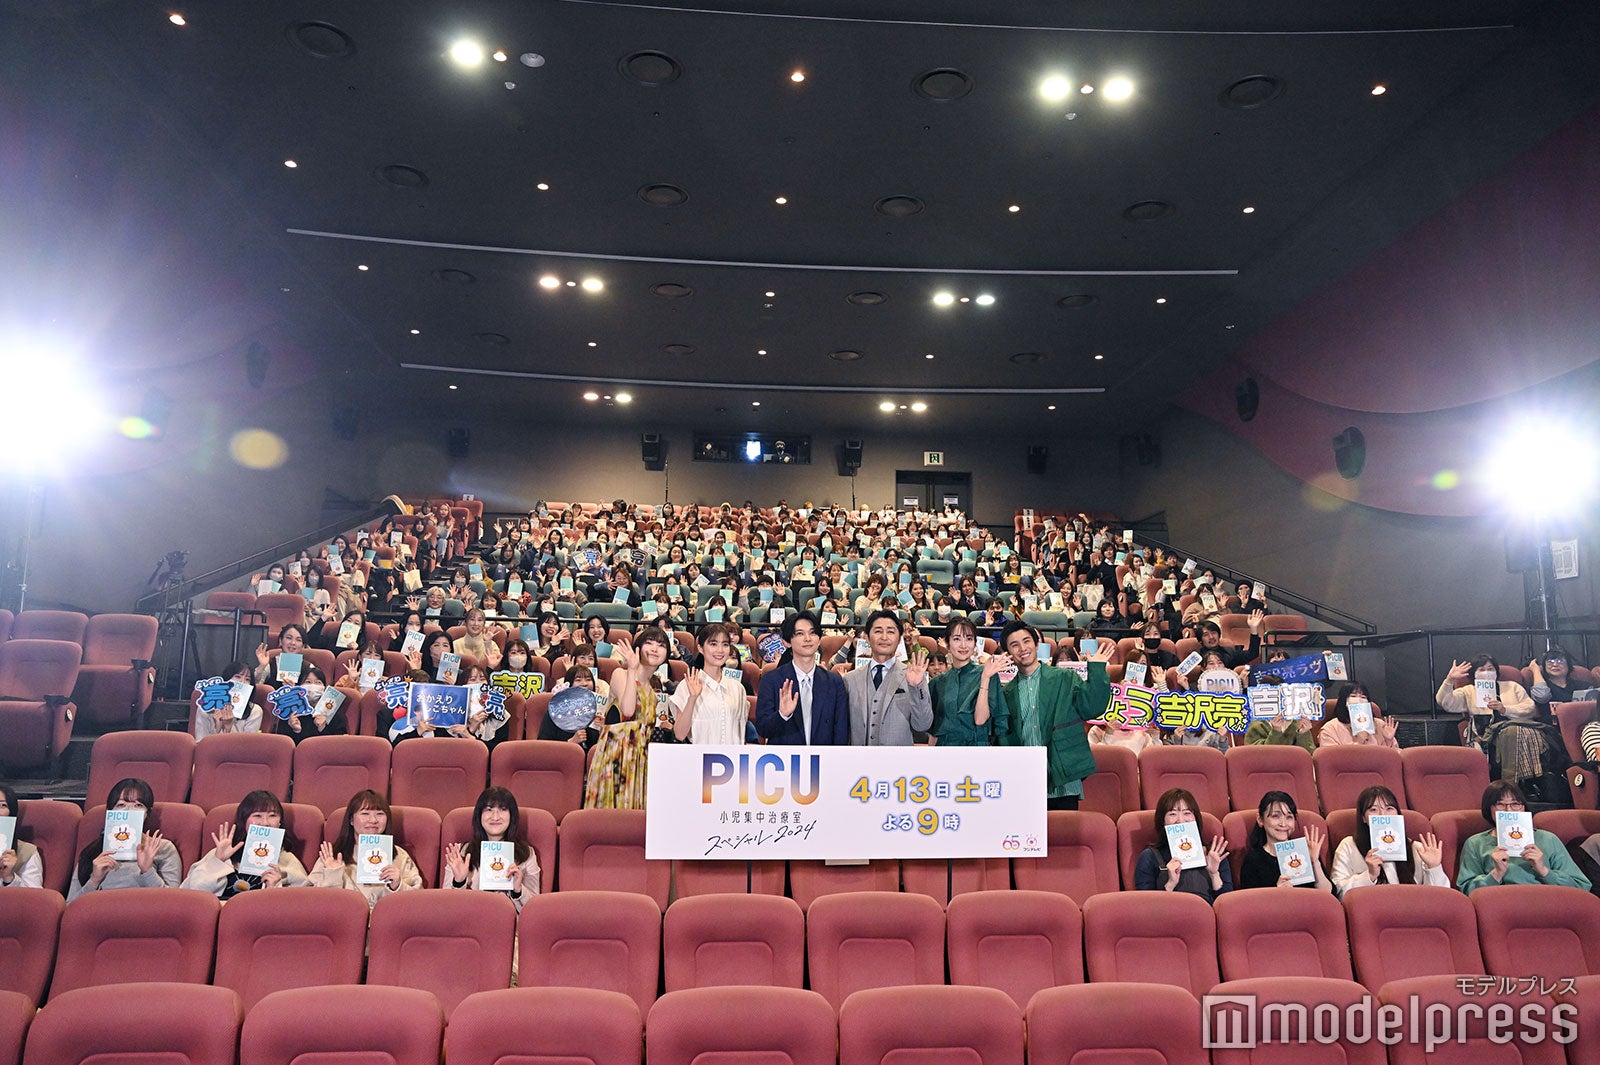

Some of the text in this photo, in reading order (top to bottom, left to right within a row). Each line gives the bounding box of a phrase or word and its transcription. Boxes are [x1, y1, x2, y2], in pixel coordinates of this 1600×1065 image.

[407, 631, 423, 641] PICU
[443, 653, 460, 663] PICU
[1327, 654, 1342, 662] PICU
[1129, 663, 1145, 673] PICU
[724, 670, 740, 678] PICU
[375, 676, 401, 690] よしざわ
[492, 673, 543, 699] 吉沢
[1206, 678, 1234, 689] PICU
[1476, 681, 1495, 690] PICU
[202, 683, 232, 710] 亮
[385, 682, 408, 708] 亮
[416, 694, 453, 704] おかえり
[275, 689, 305, 718] 亮
[485, 690, 506, 715] 亮
[1252, 687, 1314, 716] 吉沢
[1159, 693, 1245, 728] 吉沢亮
[702, 753, 820, 805] PICU
[850, 776, 1001, 803] 4月13日土曜
[107, 812, 129, 821] PICU
[719, 811, 802, 824] 小児集中治療室
[882, 808, 961, 835] よる9時
[1371, 816, 1390, 825] PICU
[1499, 812, 1518, 821] PICU
[250, 826, 270, 837] PICU
[1167, 825, 1185, 835] PICU
[360, 835, 380, 845] PICU
[704, 820, 817, 856] スペシャル 2024
[1002, 834, 1020, 850] 65
[482, 842, 502, 851] PICU
[1276, 842, 1295, 851] PICU
